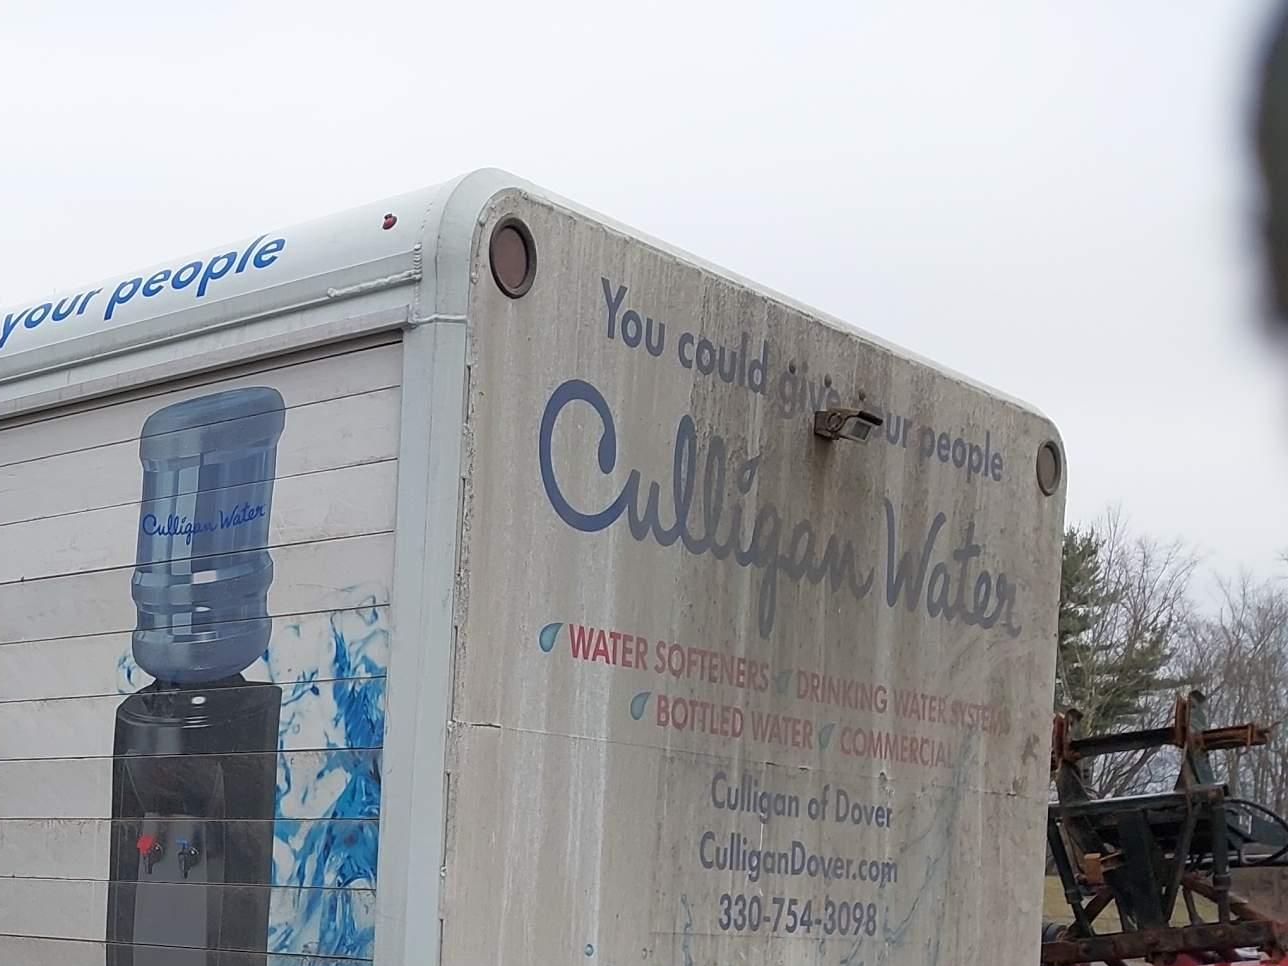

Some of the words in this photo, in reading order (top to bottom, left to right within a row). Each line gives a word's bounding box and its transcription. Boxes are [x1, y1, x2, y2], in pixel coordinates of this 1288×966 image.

[104, 233, 286, 321] people
[600, 277, 666, 358] You
[677, 331, 770, 396] could
[919, 426, 1004, 484] people
[142, 513, 217, 545] Culligan
[218, 503, 267, 529] Water
[538, 378, 876, 640] Culligan
[882, 497, 1022, 637] Water
[568, 623, 648, 671] WATER
[654, 640, 769, 693] SOFTENERS
[796, 669, 888, 714] DRINKING
[891, 687, 946, 723] WATER
[950, 702, 1010, 737] SYSTEMS
[656, 693, 744, 738] BOTTLED
[752, 710, 813, 750] WATER
[840, 727, 955, 769] COMMERCIAL
[712, 770, 800, 824] Culligan
[807, 784, 830, 821] of
[835, 788, 893, 828] Dover
[699, 830, 898, 883] CulliganDover.com
[718, 894, 877, 936] 330-754-3098
